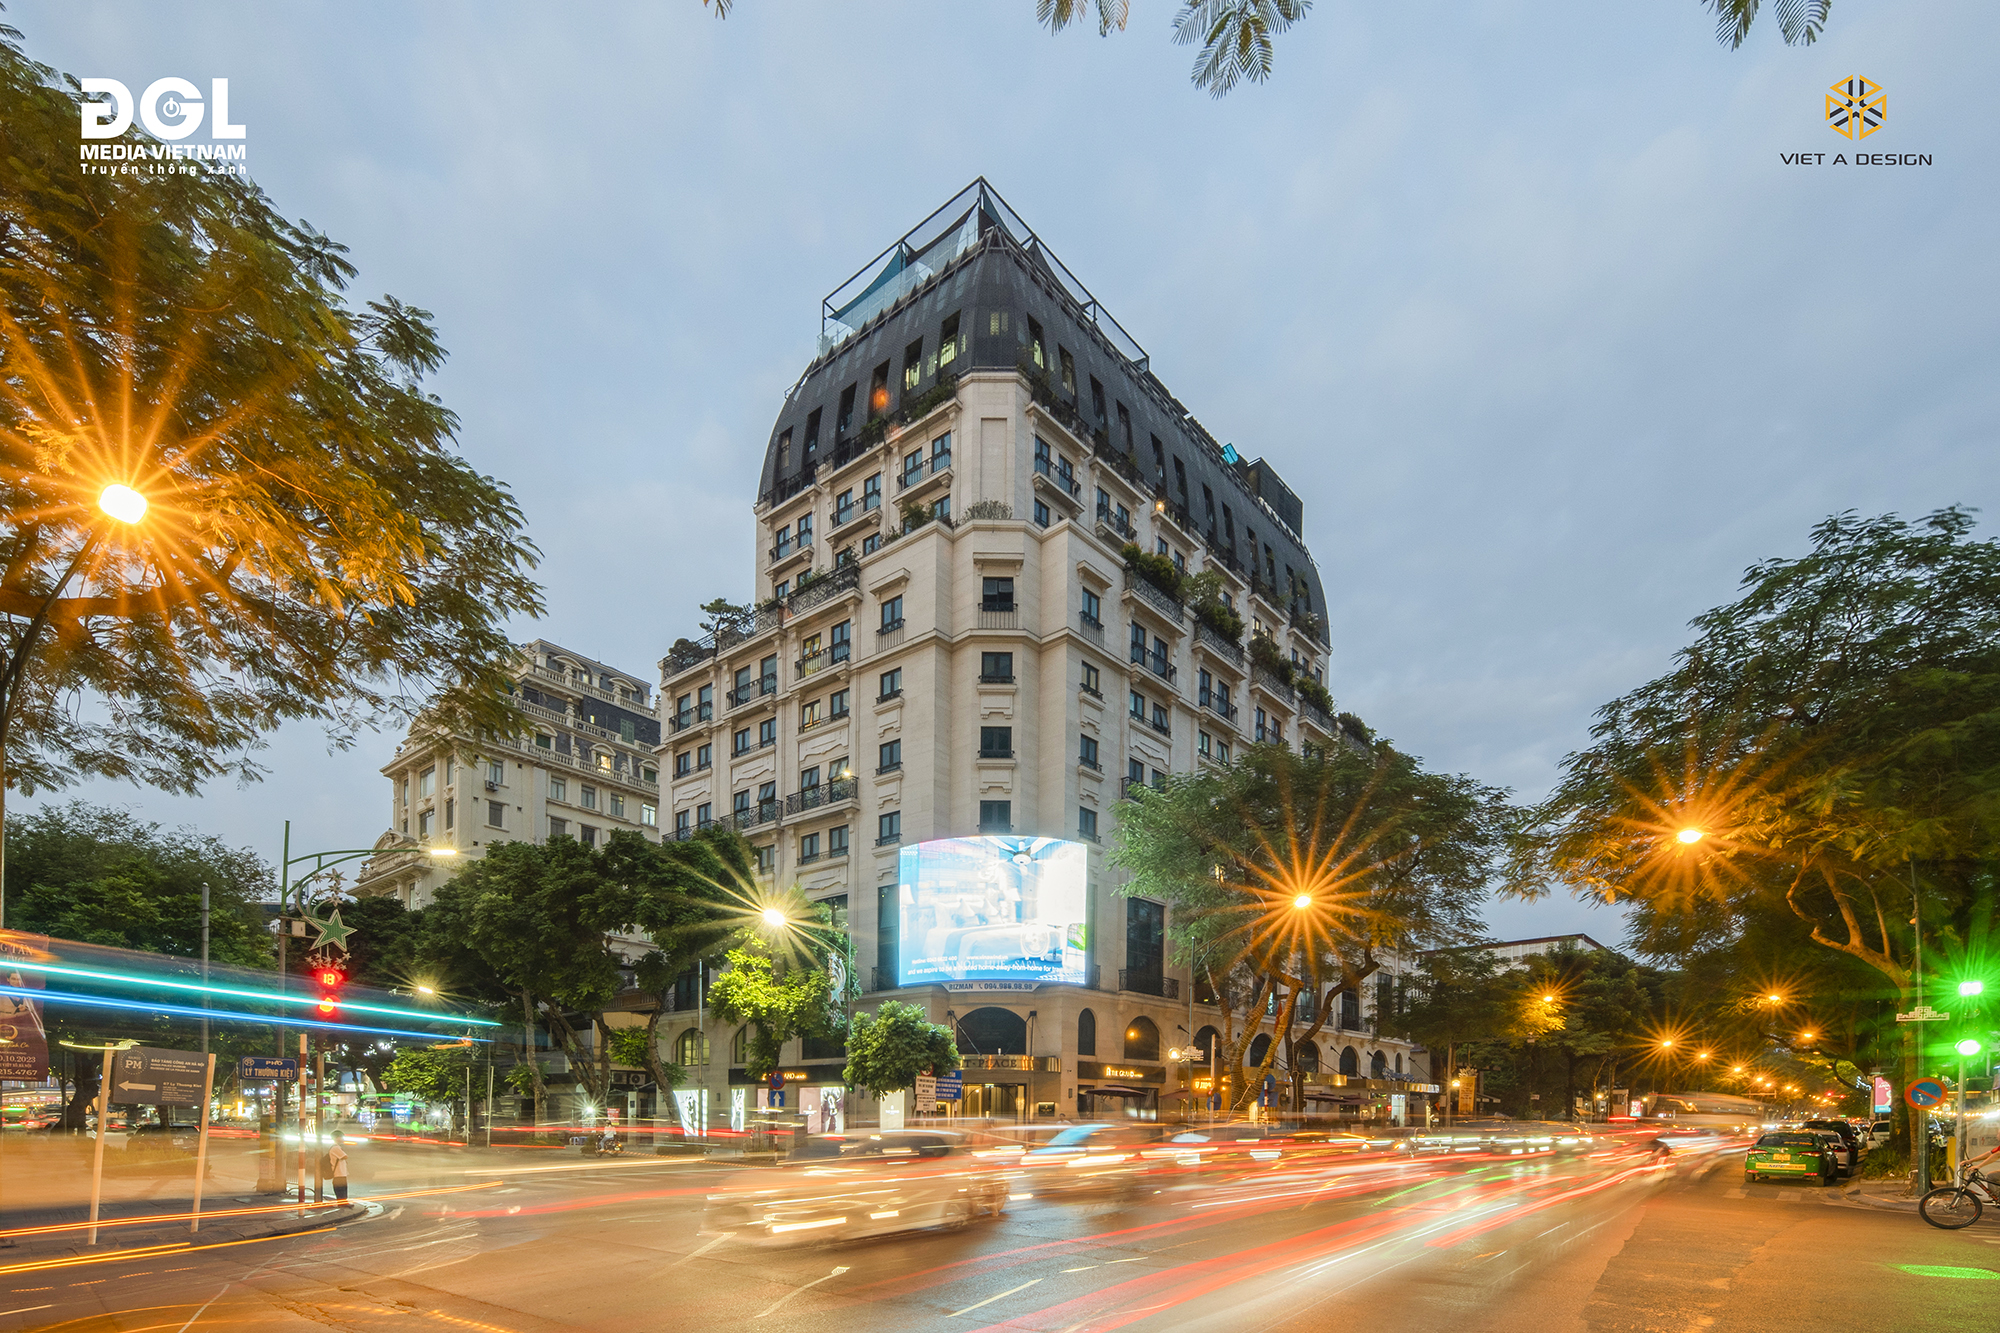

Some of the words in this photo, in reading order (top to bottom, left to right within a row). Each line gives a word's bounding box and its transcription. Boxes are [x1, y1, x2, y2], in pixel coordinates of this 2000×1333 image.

[324, 973, 335, 985] 18
[125, 1060, 142, 1069] PM
[280, 1067, 293, 1080] KIỆT
